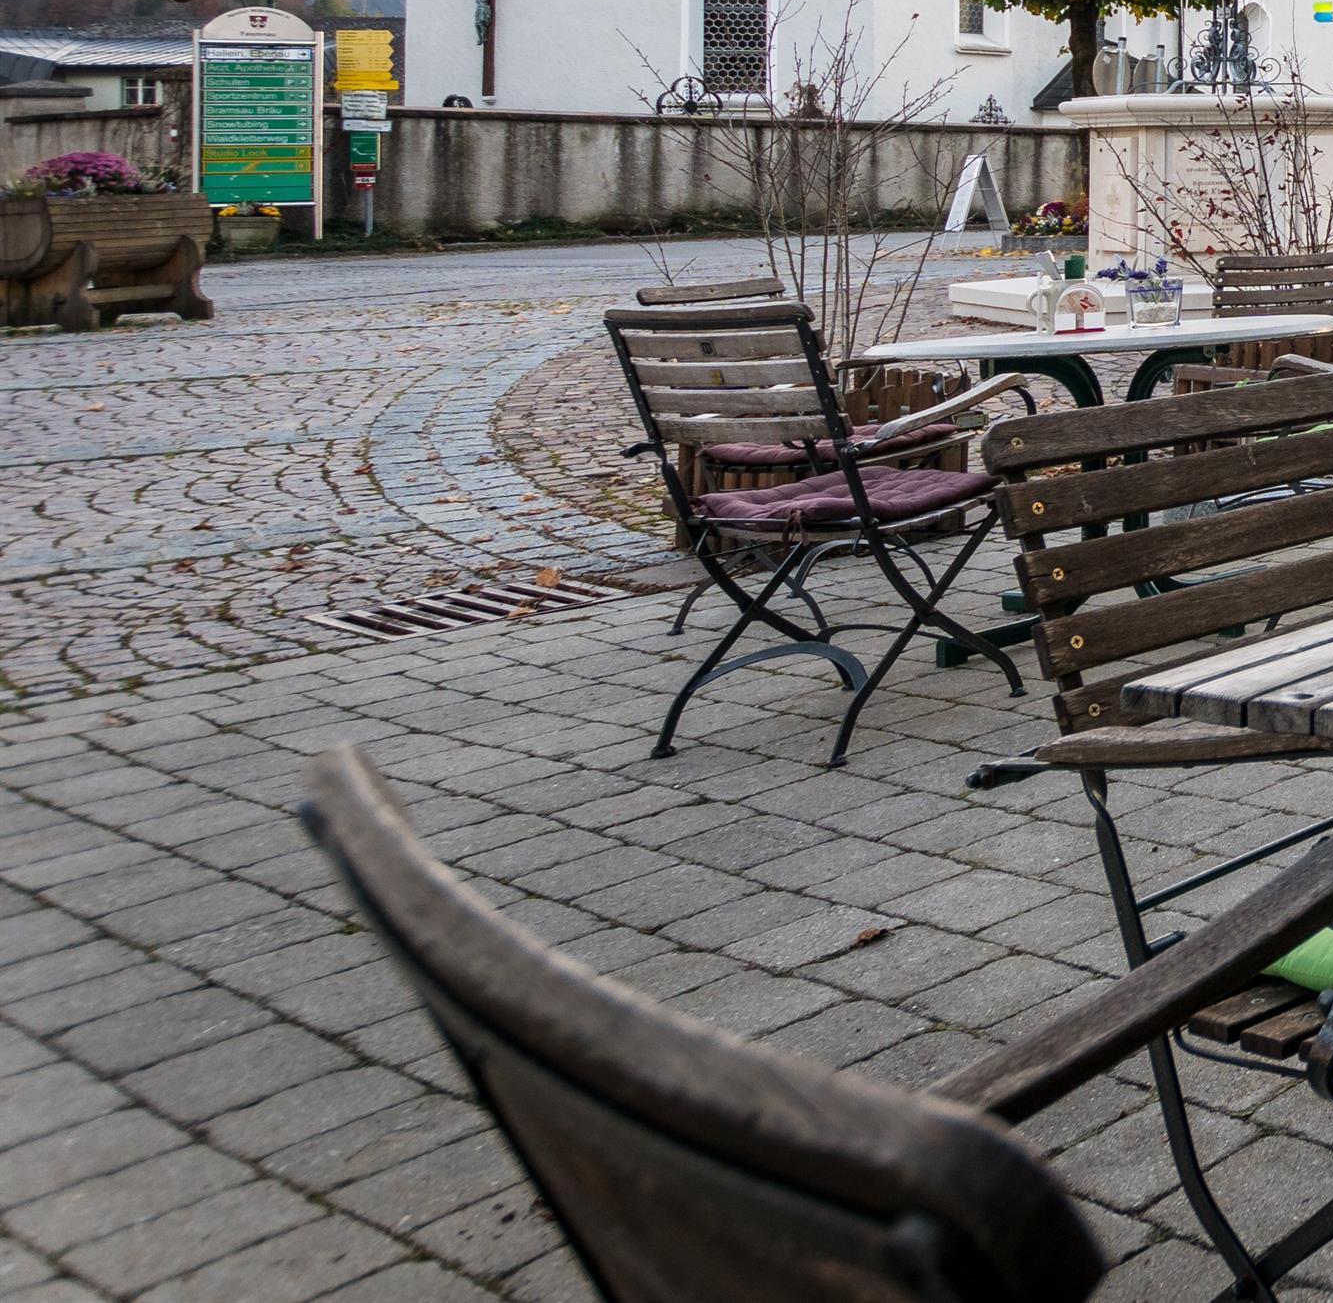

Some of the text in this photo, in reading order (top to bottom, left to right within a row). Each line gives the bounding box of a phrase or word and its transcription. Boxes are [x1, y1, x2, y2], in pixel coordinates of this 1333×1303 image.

[207, 78, 250, 86] Schulen
[207, 92, 278, 101] Sportzentrum
[207, 120, 269, 129] Snowtubing
